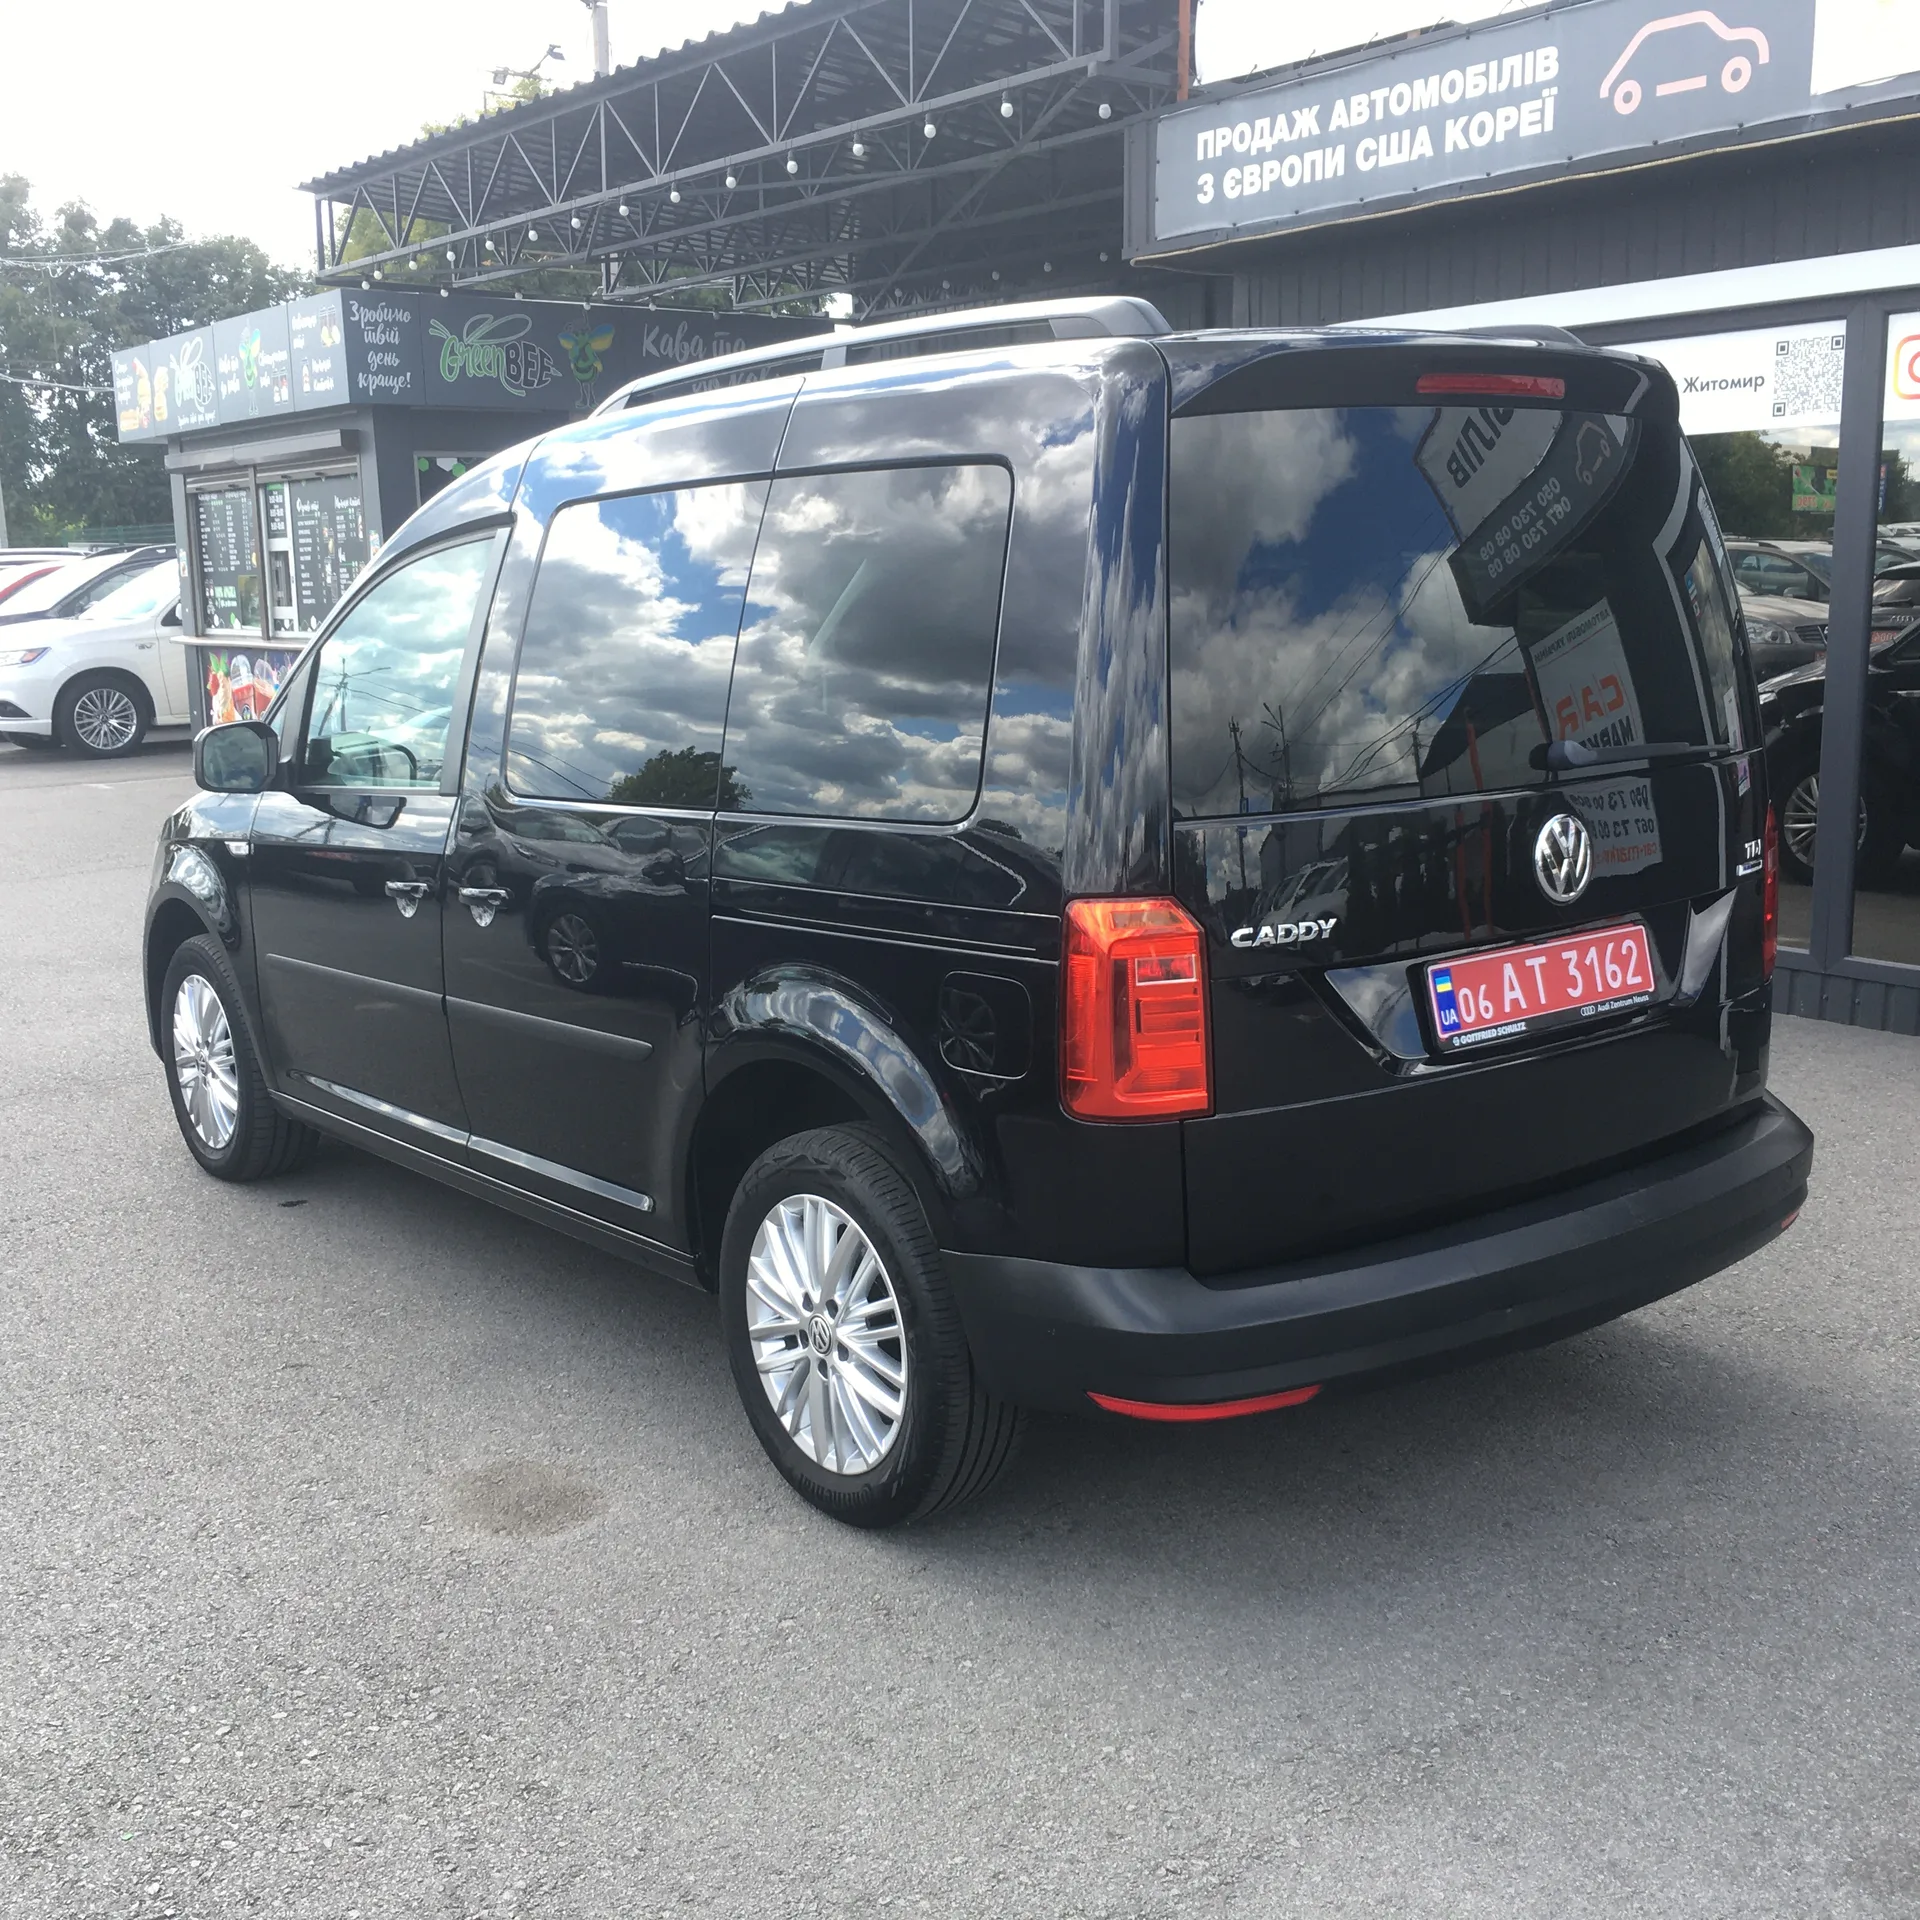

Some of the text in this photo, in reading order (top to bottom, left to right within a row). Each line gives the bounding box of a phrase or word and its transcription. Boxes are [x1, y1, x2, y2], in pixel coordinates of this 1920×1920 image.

[1196, 45, 1560, 163] ПРОДАЖ АВТОМОБІЛІВ
[1196, 88, 1556, 205] З ЄВРОПИ США КОРЕЇ
[349, 300, 412, 328] Зробимо
[363, 322, 401, 345] твій
[367, 350, 401, 372] день
[357, 371, 412, 396] краще!
[1683, 375, 1765, 394] Житомир
[1230, 918, 1337, 948] CADDY
[1441, 939, 1643, 1026] UA 06 AT 3162
[1597, 994, 1650, 1013] Audi Zentrum Neuss
[1460, 1021, 1527, 1045] GOTTFRIED SCHULTZ
